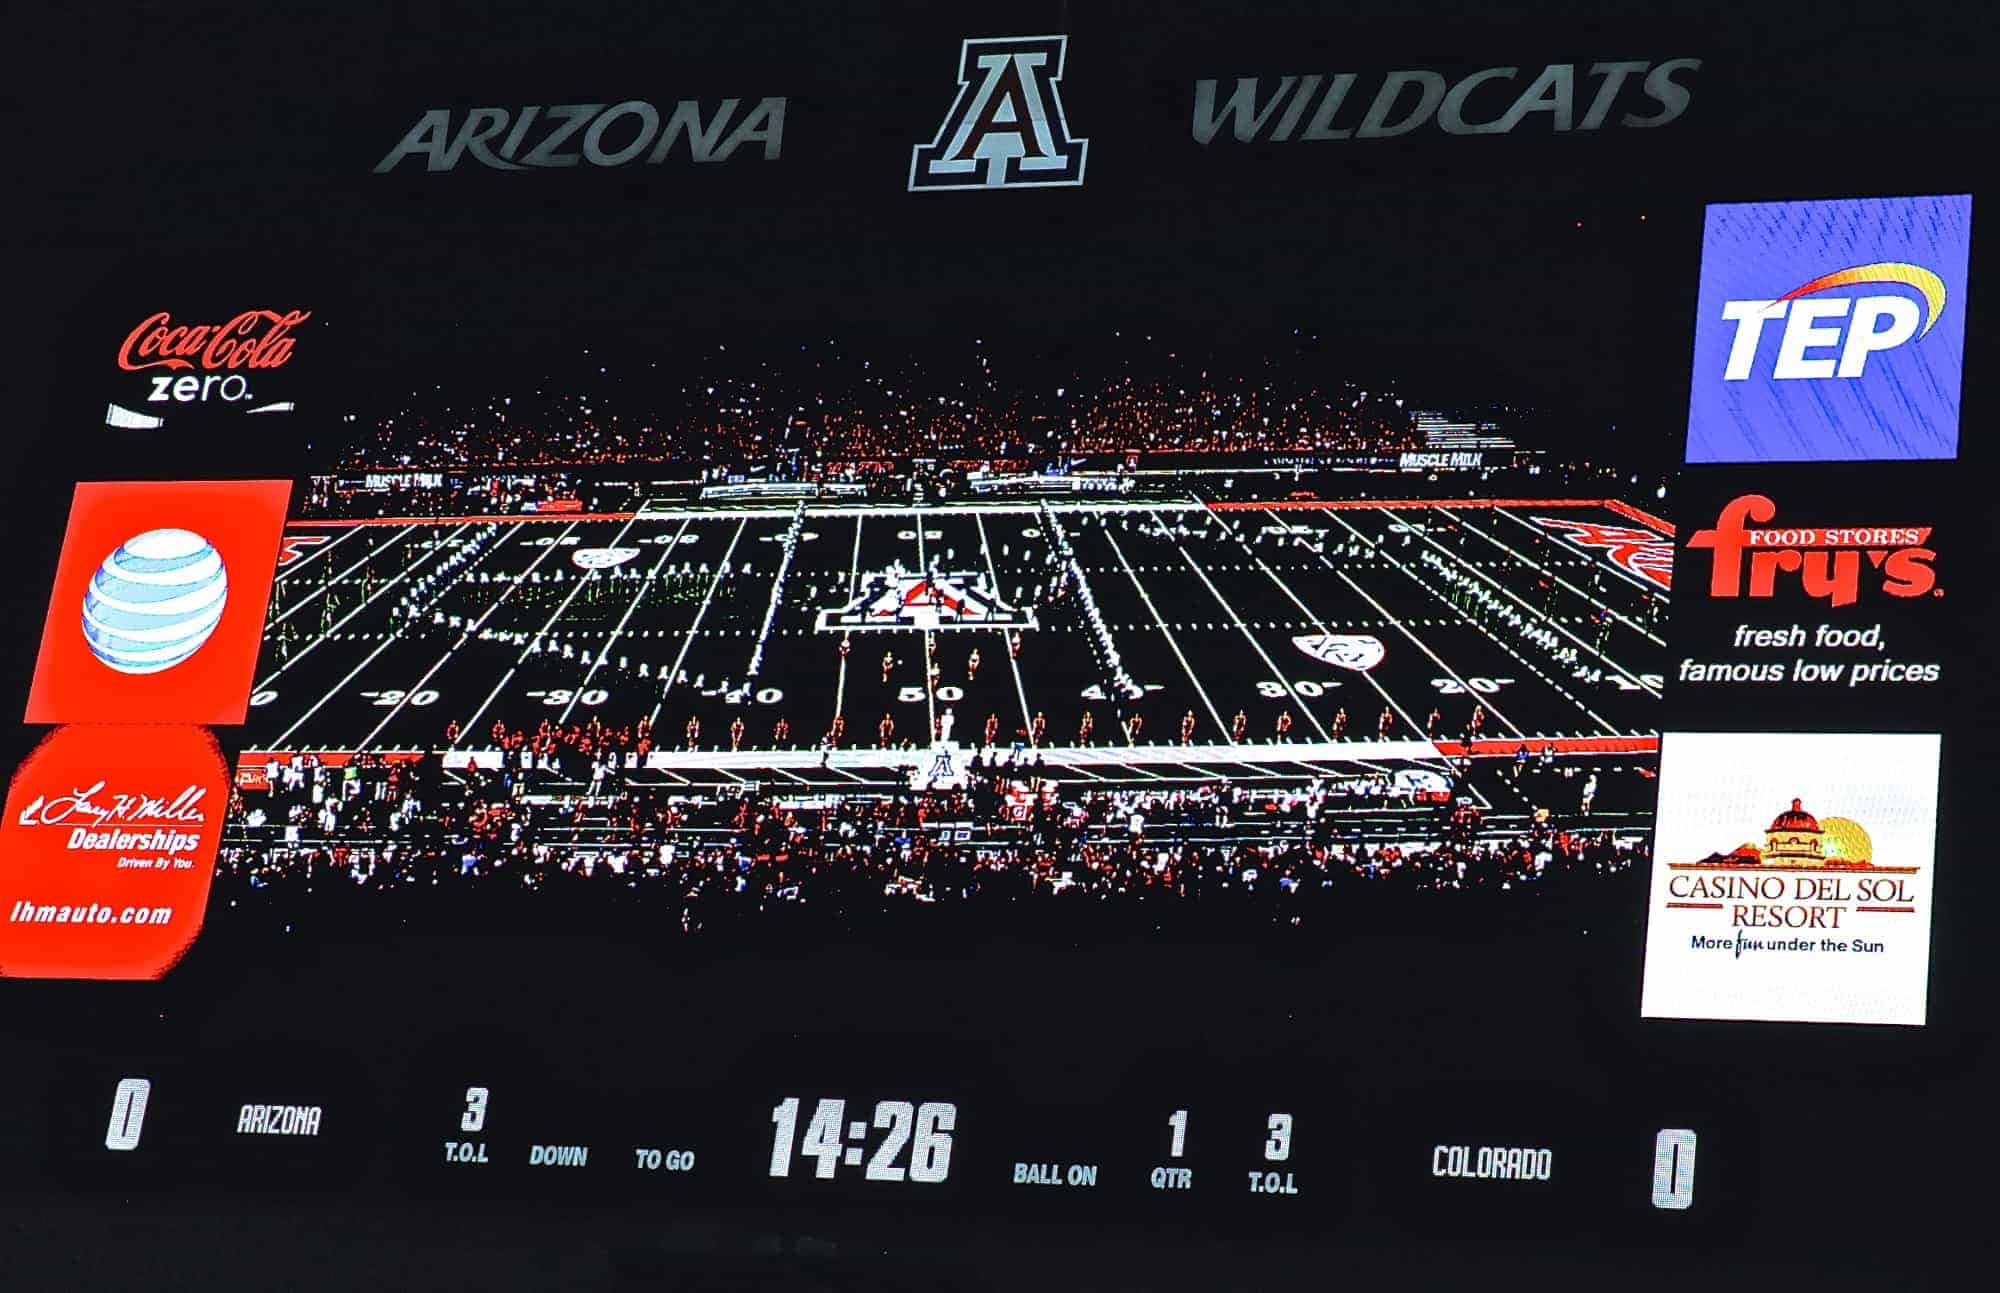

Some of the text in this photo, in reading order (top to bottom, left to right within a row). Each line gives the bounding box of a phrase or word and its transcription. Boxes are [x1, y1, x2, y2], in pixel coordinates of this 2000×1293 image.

[373, 57, 1703, 173] ARIZONA WILDCATS
[118, 310, 311, 371] Coca-Cola
[1721, 295, 1921, 380] TEP
[1399, 452, 1450, 468] MUSCLE
[1450, 452, 1484, 467] MILK
[1750, 528, 1920, 545] FOOD STORES
[1686, 494, 1938, 608] fry's
[1734, 624, 1885, 650] fresh food,
[1679, 658, 1941, 686] famous low prices
[898, 686, 964, 702] 50
[67, 827, 201, 855] Dealerships
[117, 856, 153, 869] Driven
[155, 857, 170, 870] By
[1669, 875, 1915, 902] CASINO DEL SOL
[10, 901, 172, 924] lhmauto.com
[1732, 905, 1847, 928] RESORT
[1691, 929, 1884, 960] More fun under the Sun
[105, 1078, 151, 1151] 0
[237, 1105, 322, 1136] ARIZONA
[461, 1087, 489, 1132] 3
[768, 1097, 957, 1183] 14:26
[1167, 1110, 1189, 1158] 1
[1264, 1113, 1293, 1161] 3
[445, 1142, 489, 1164] T.O.L
[529, 1145, 588, 1168] DOWN
[636, 1149, 695, 1172] TO GO
[1432, 1145, 1553, 1181] COLORADO
[1013, 1163, 1097, 1187] BALL ON
[1150, 1167, 1193, 1190] QTR
[1248, 1171, 1298, 1195] T.O.L
[1651, 1128, 1698, 1210] 0
